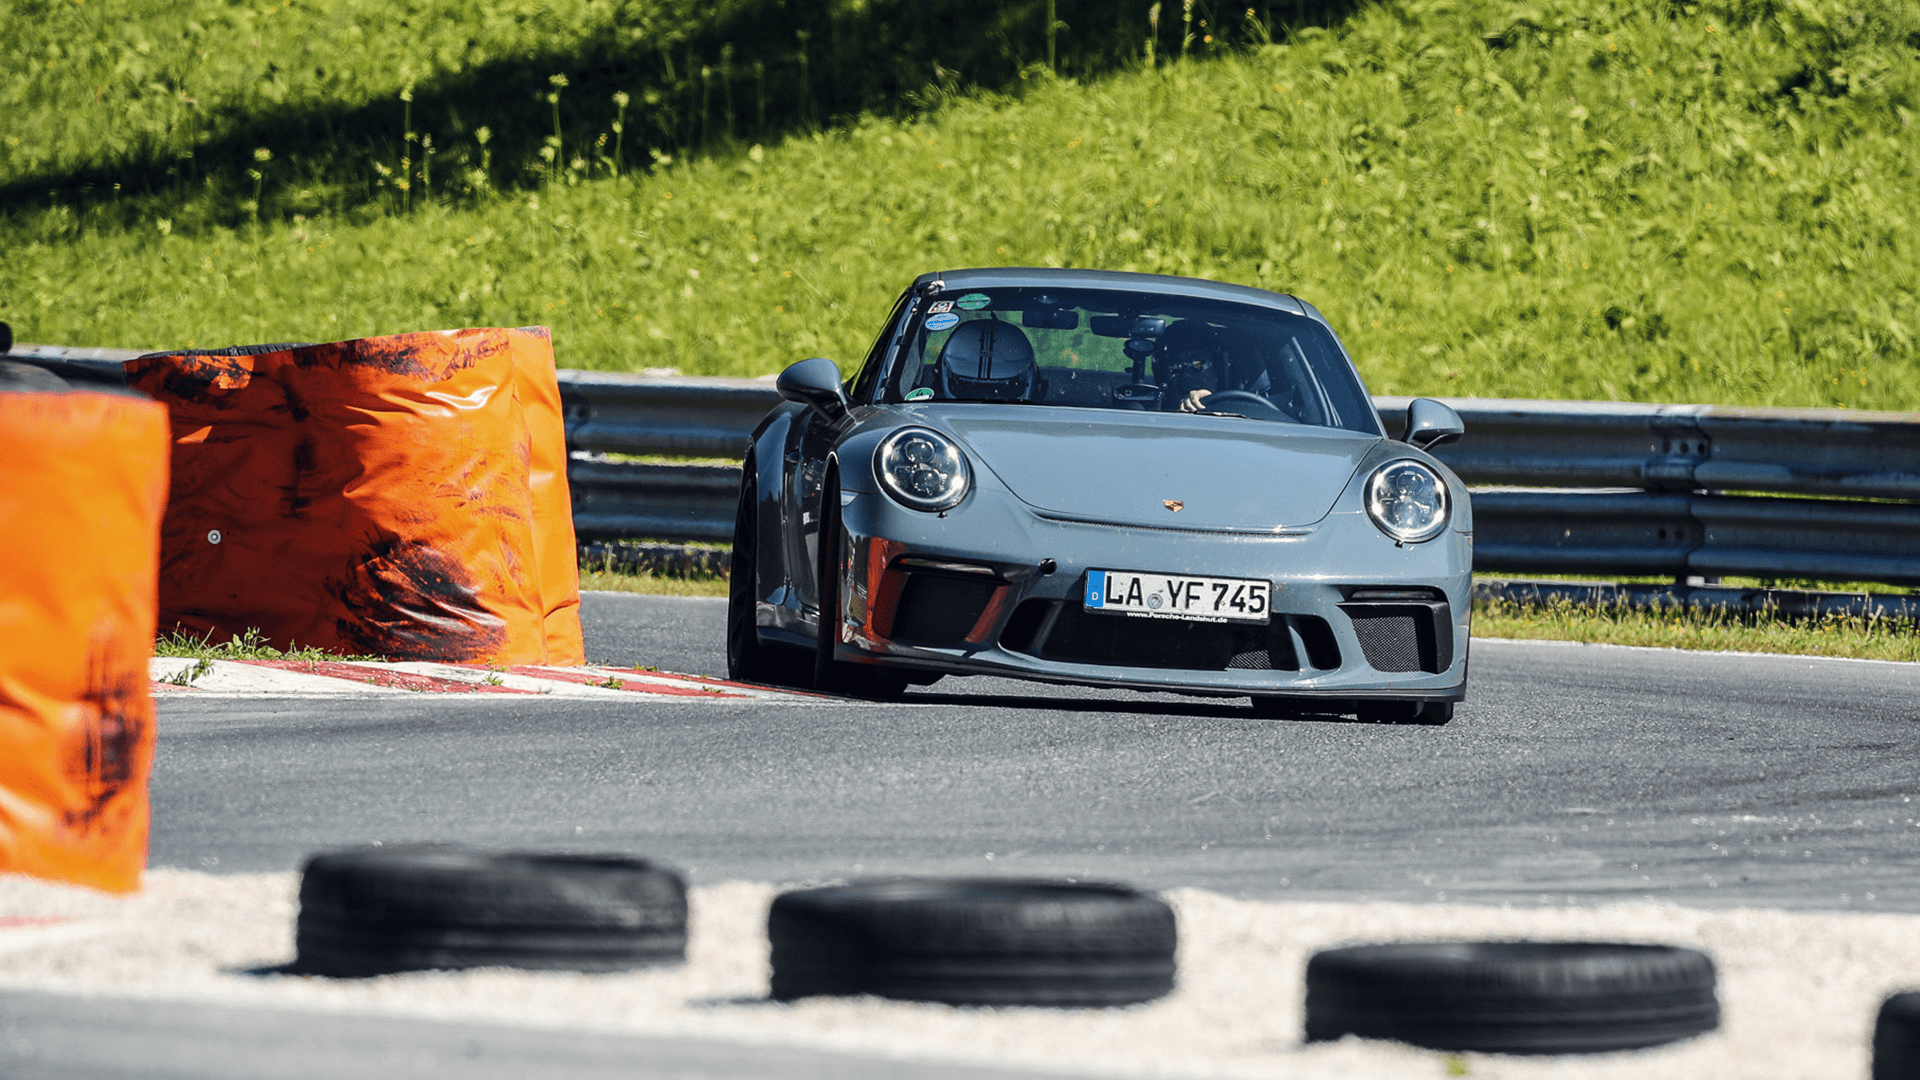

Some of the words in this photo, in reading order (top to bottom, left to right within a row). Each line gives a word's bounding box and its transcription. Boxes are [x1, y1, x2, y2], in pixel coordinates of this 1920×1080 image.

[1091, 591, 1099, 601] D
[1105, 575, 1144, 606] LA
[1166, 579, 1204, 610] YF
[1211, 583, 1267, 614] 745
[1126, 611, 1228, 623] www.Porsche-Landshut.de
